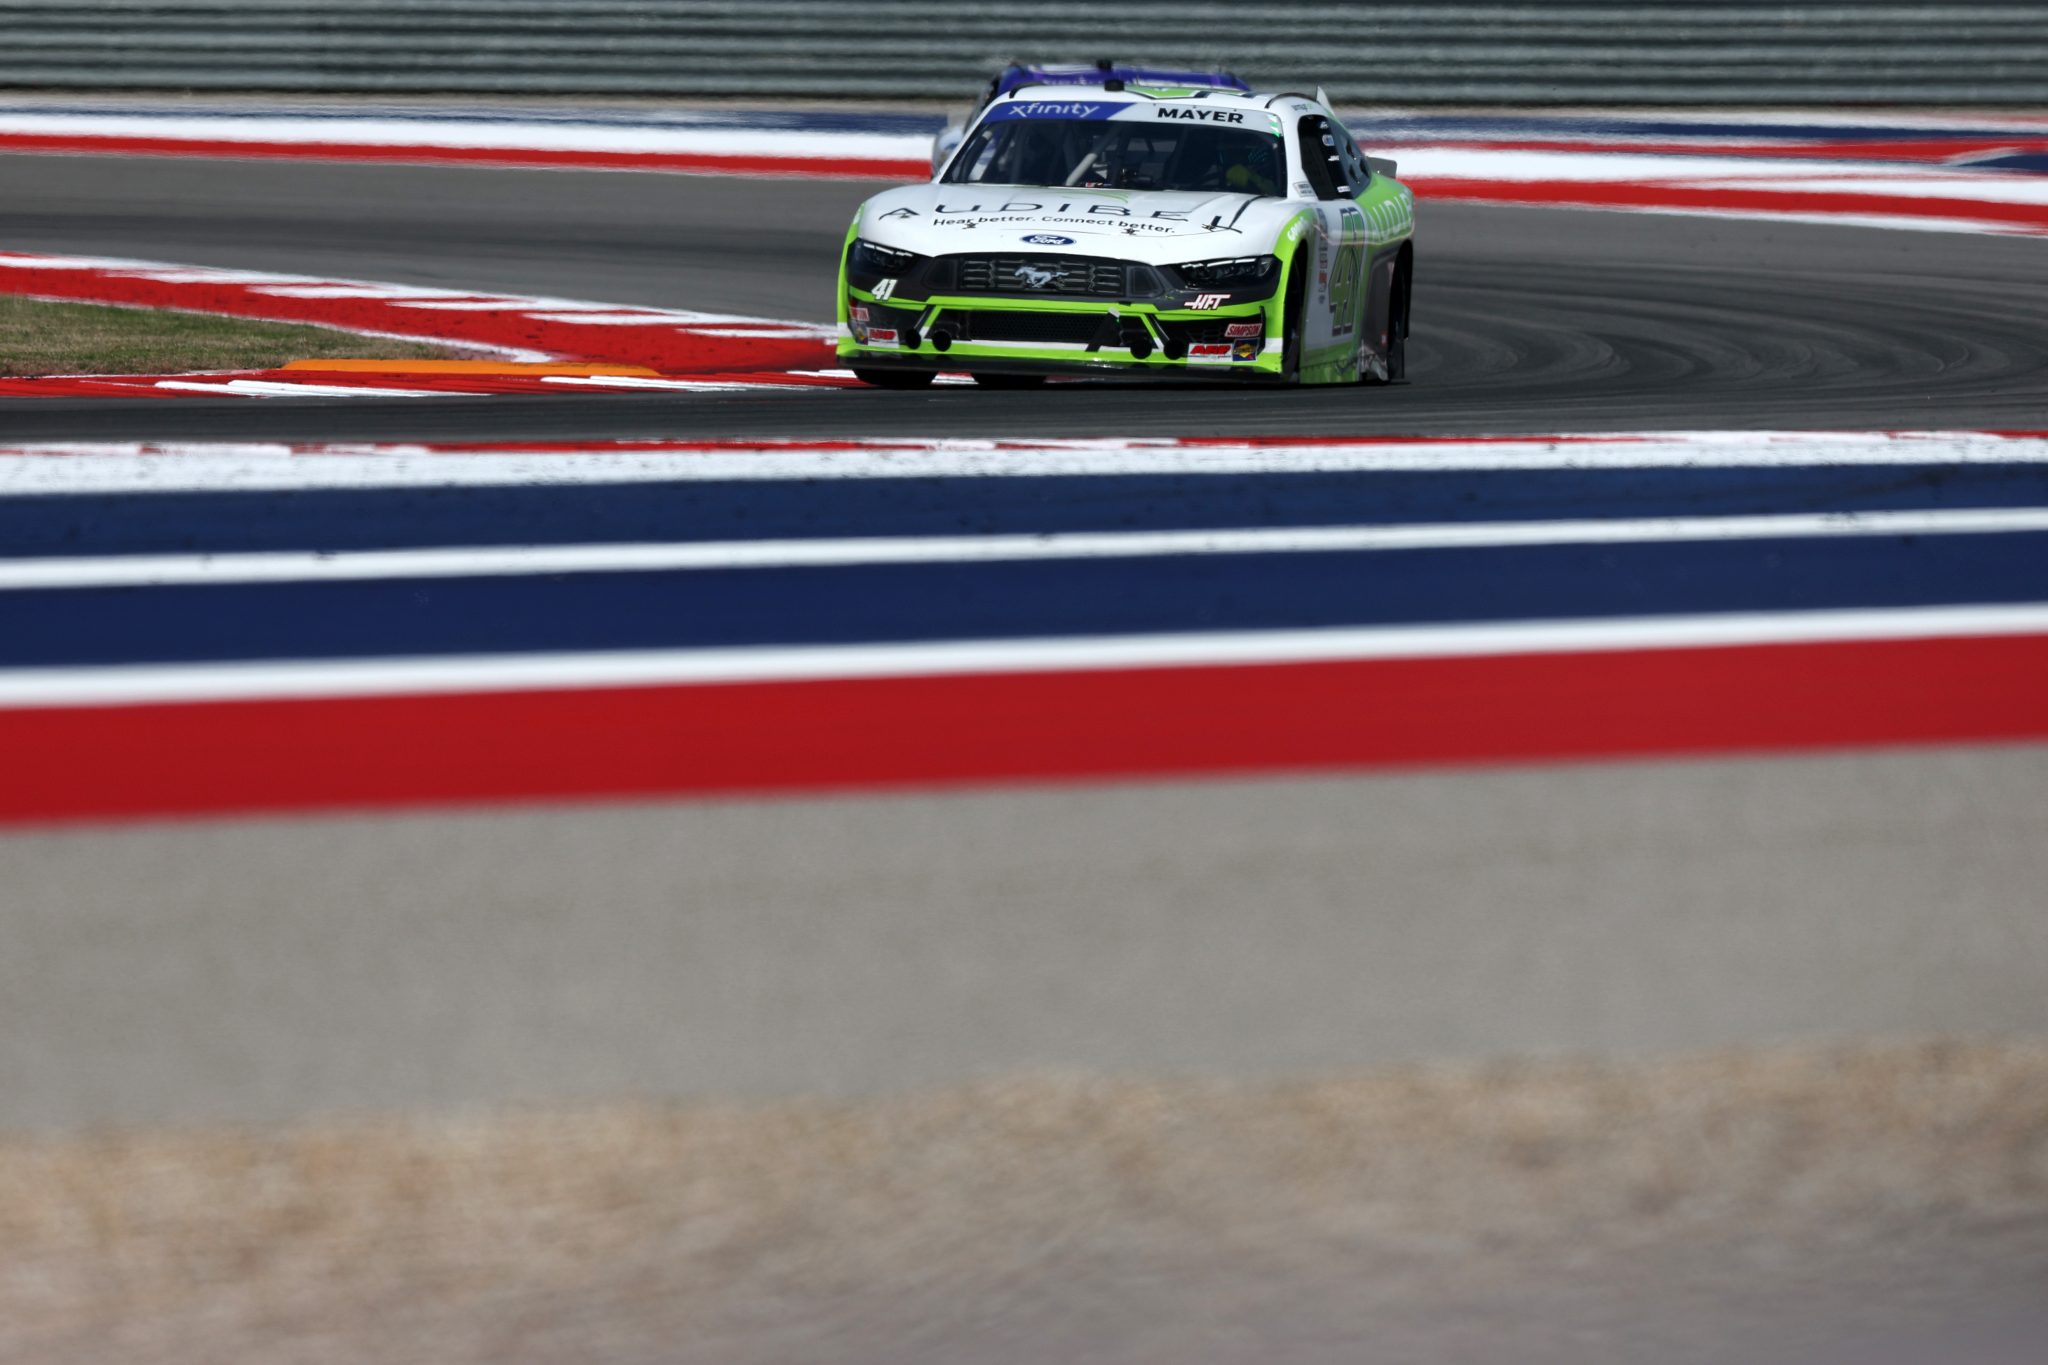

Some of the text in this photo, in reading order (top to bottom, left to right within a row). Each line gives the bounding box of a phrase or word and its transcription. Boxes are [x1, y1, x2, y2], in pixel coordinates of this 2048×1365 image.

[1008, 102, 1100, 118] xfinity
[1157, 107, 1244, 124] MAYER
[879, 202, 1243, 234] AUDIBEL
[933, 215, 1175, 233] Hear better. Connect better.
[871, 278, 898, 301] 41
[1183, 293, 1232, 310] HFT
[1227, 324, 1261, 336] SIMPSON
